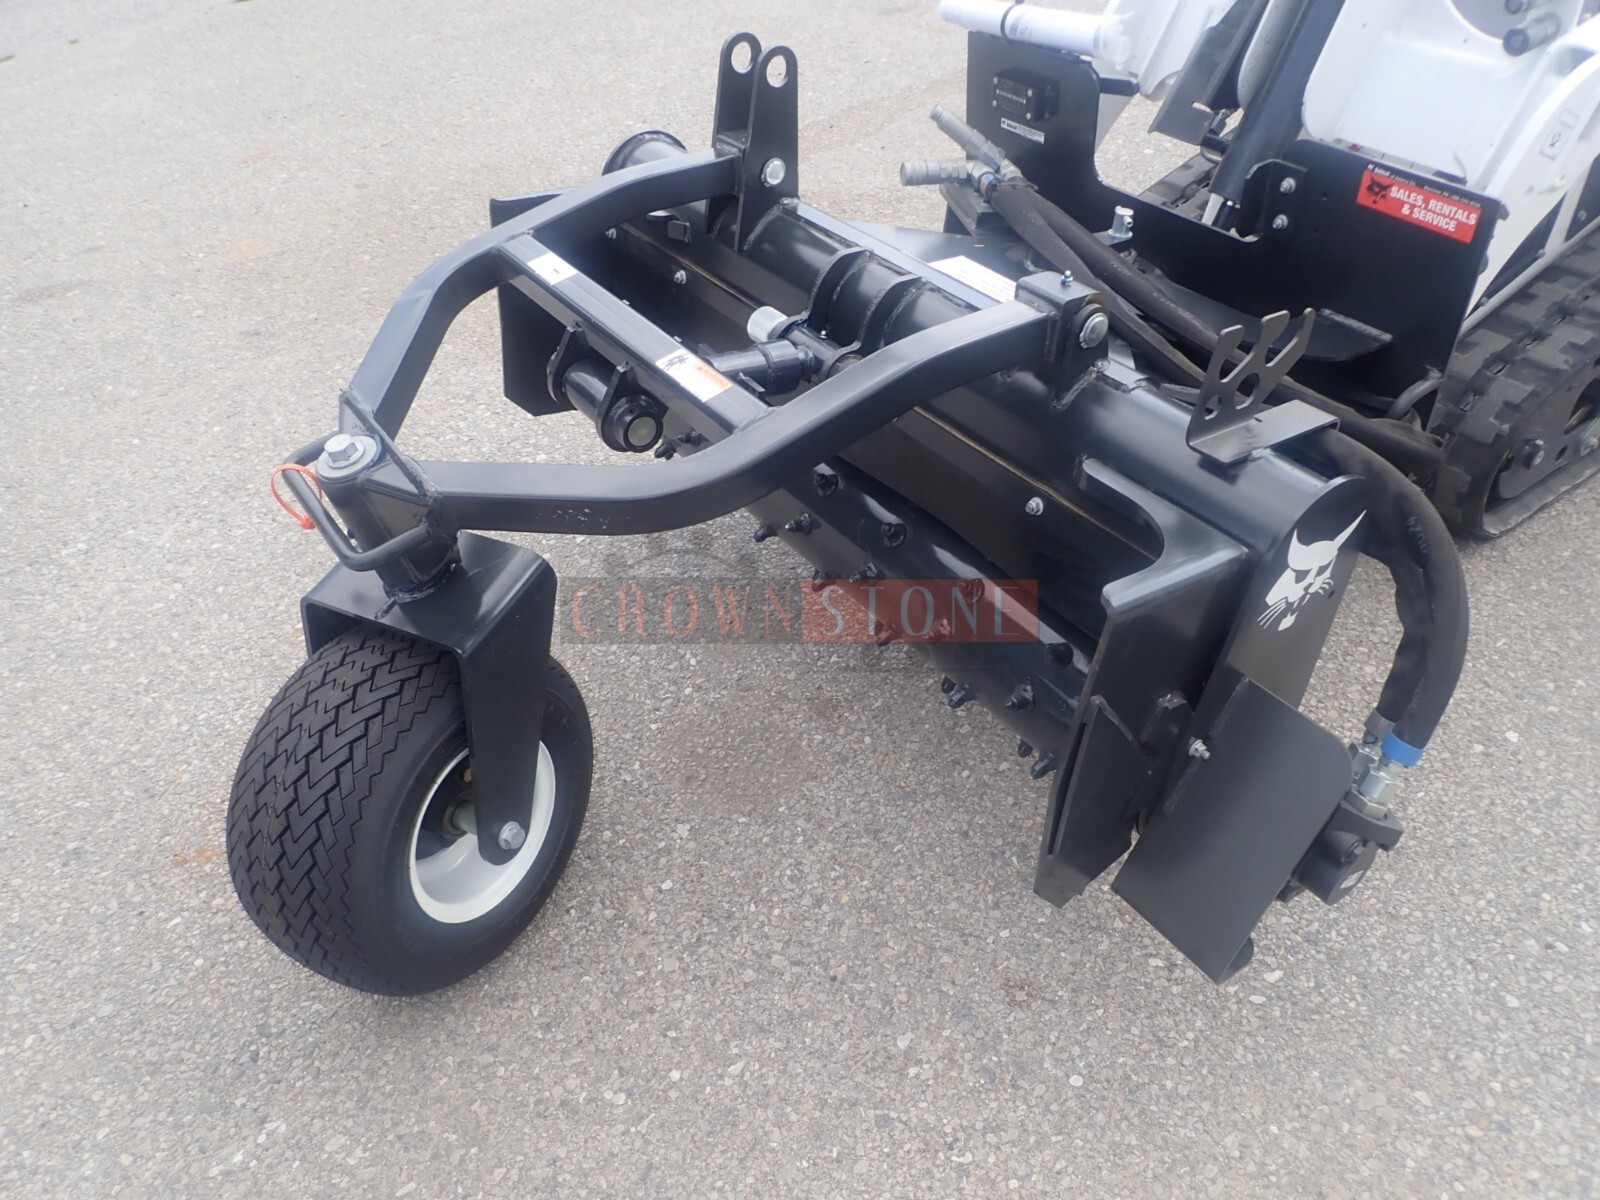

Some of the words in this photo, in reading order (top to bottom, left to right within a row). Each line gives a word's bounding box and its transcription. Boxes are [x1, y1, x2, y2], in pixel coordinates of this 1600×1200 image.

[1390, 186, 1425, 208] SALES,
[1428, 199, 1477, 225] RENTALS
[1401, 204, 1410, 215] &
[1412, 207, 1457, 231] SERVICE
